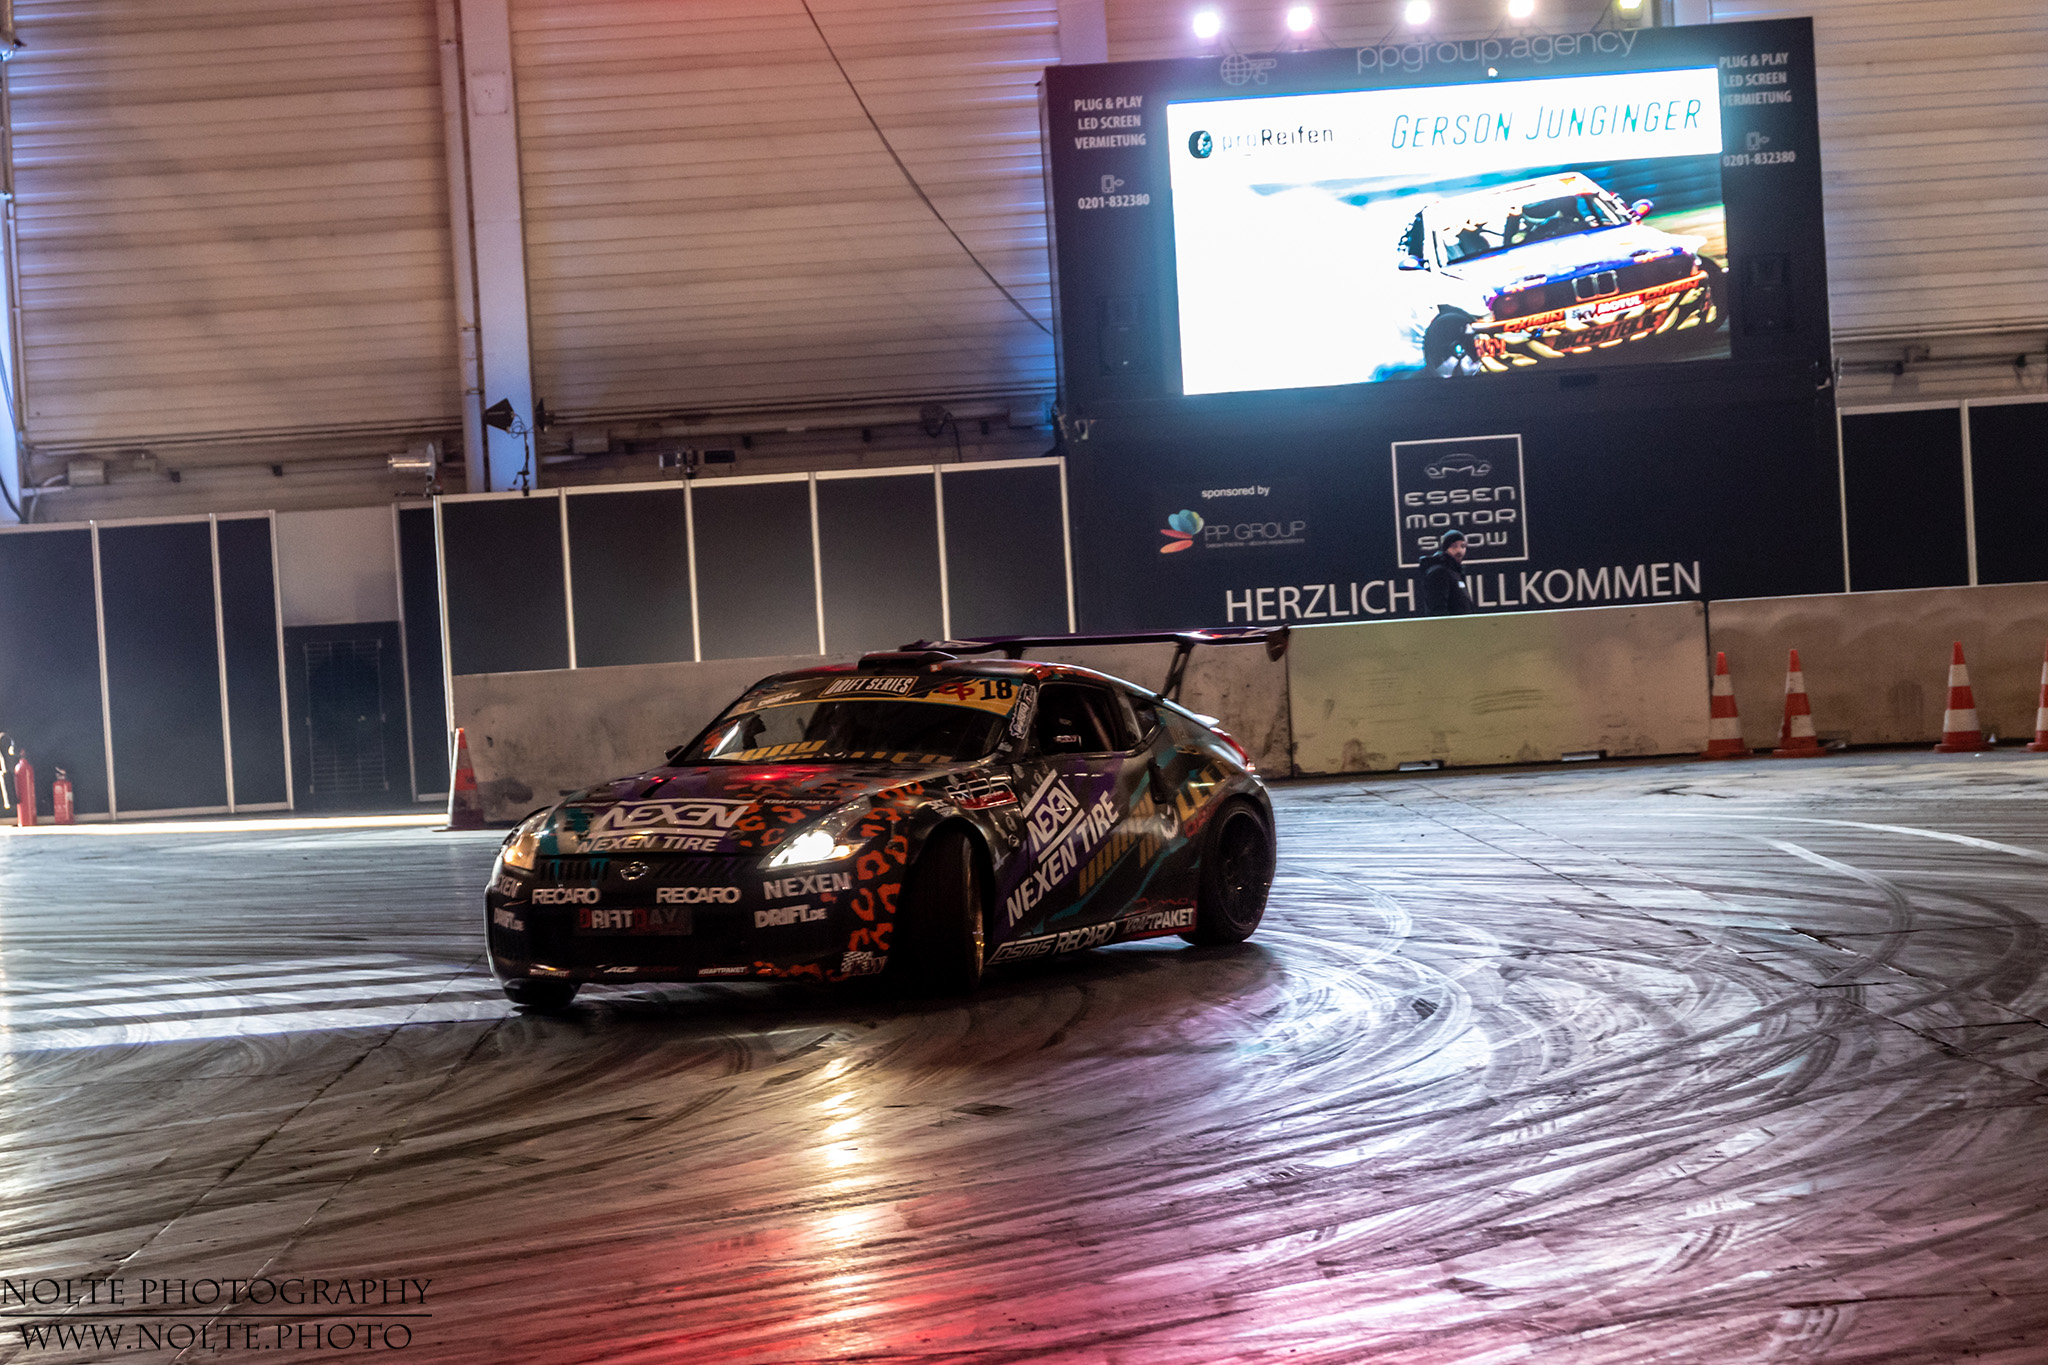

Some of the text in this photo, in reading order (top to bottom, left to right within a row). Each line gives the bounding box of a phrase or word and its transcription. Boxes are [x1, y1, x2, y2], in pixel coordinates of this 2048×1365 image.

[1356, 30, 1638, 75] ppgroup.agency
[1719, 52, 1788, 69] PLUG & PLAY
[1723, 71, 1787, 88] LED SCREEN
[1074, 96, 1143, 112] PLUG & PLAY
[1721, 90, 1792, 107] VERMIETUNG
[1078, 115, 1141, 131] LED SCREEN
[1391, 99, 1702, 149] GERSON JUNGINGER
[1075, 133, 1147, 150] VERMIETUNG
[1222, 125, 1334, 152] proReifen
[1723, 150, 1796, 167] 0201-832380
[1078, 194, 1150, 210] 0201-832380
[1597, 295, 1643, 314] MOTUL
[1201, 485, 1271, 499] sponsored by
[1404, 485, 1516, 507] ESSEN
[1405, 508, 1517, 529] MOTOR
[1204, 520, 1306, 541] PP GROUP
[1417, 530, 1508, 551] SOW
[1226, 561, 1701, 623] HERZLICH ILLKOMMEN
[824, 677, 914, 696] DRIFT SERIES
[979, 678, 1012, 701] 18
[763, 798, 836, 806] KRAFTPAKET
[599, 803, 749, 829] NEXEN
[1025, 779, 1080, 851] NEXEN
[577, 835, 724, 853] NEXEN TIRE
[1006, 791, 1120, 928] NEXEN TIRE
[656, 887, 743, 904] RECARO
[763, 872, 853, 900] NEXEN
[532, 887, 600, 905] RECARO
[754, 904, 828, 928] DRIFT.DE
[1053, 921, 1118, 955] RECARO
[1123, 907, 1195, 934] KRAFTPAKET
[697, 966, 746, 976] KRAFTPAKET
